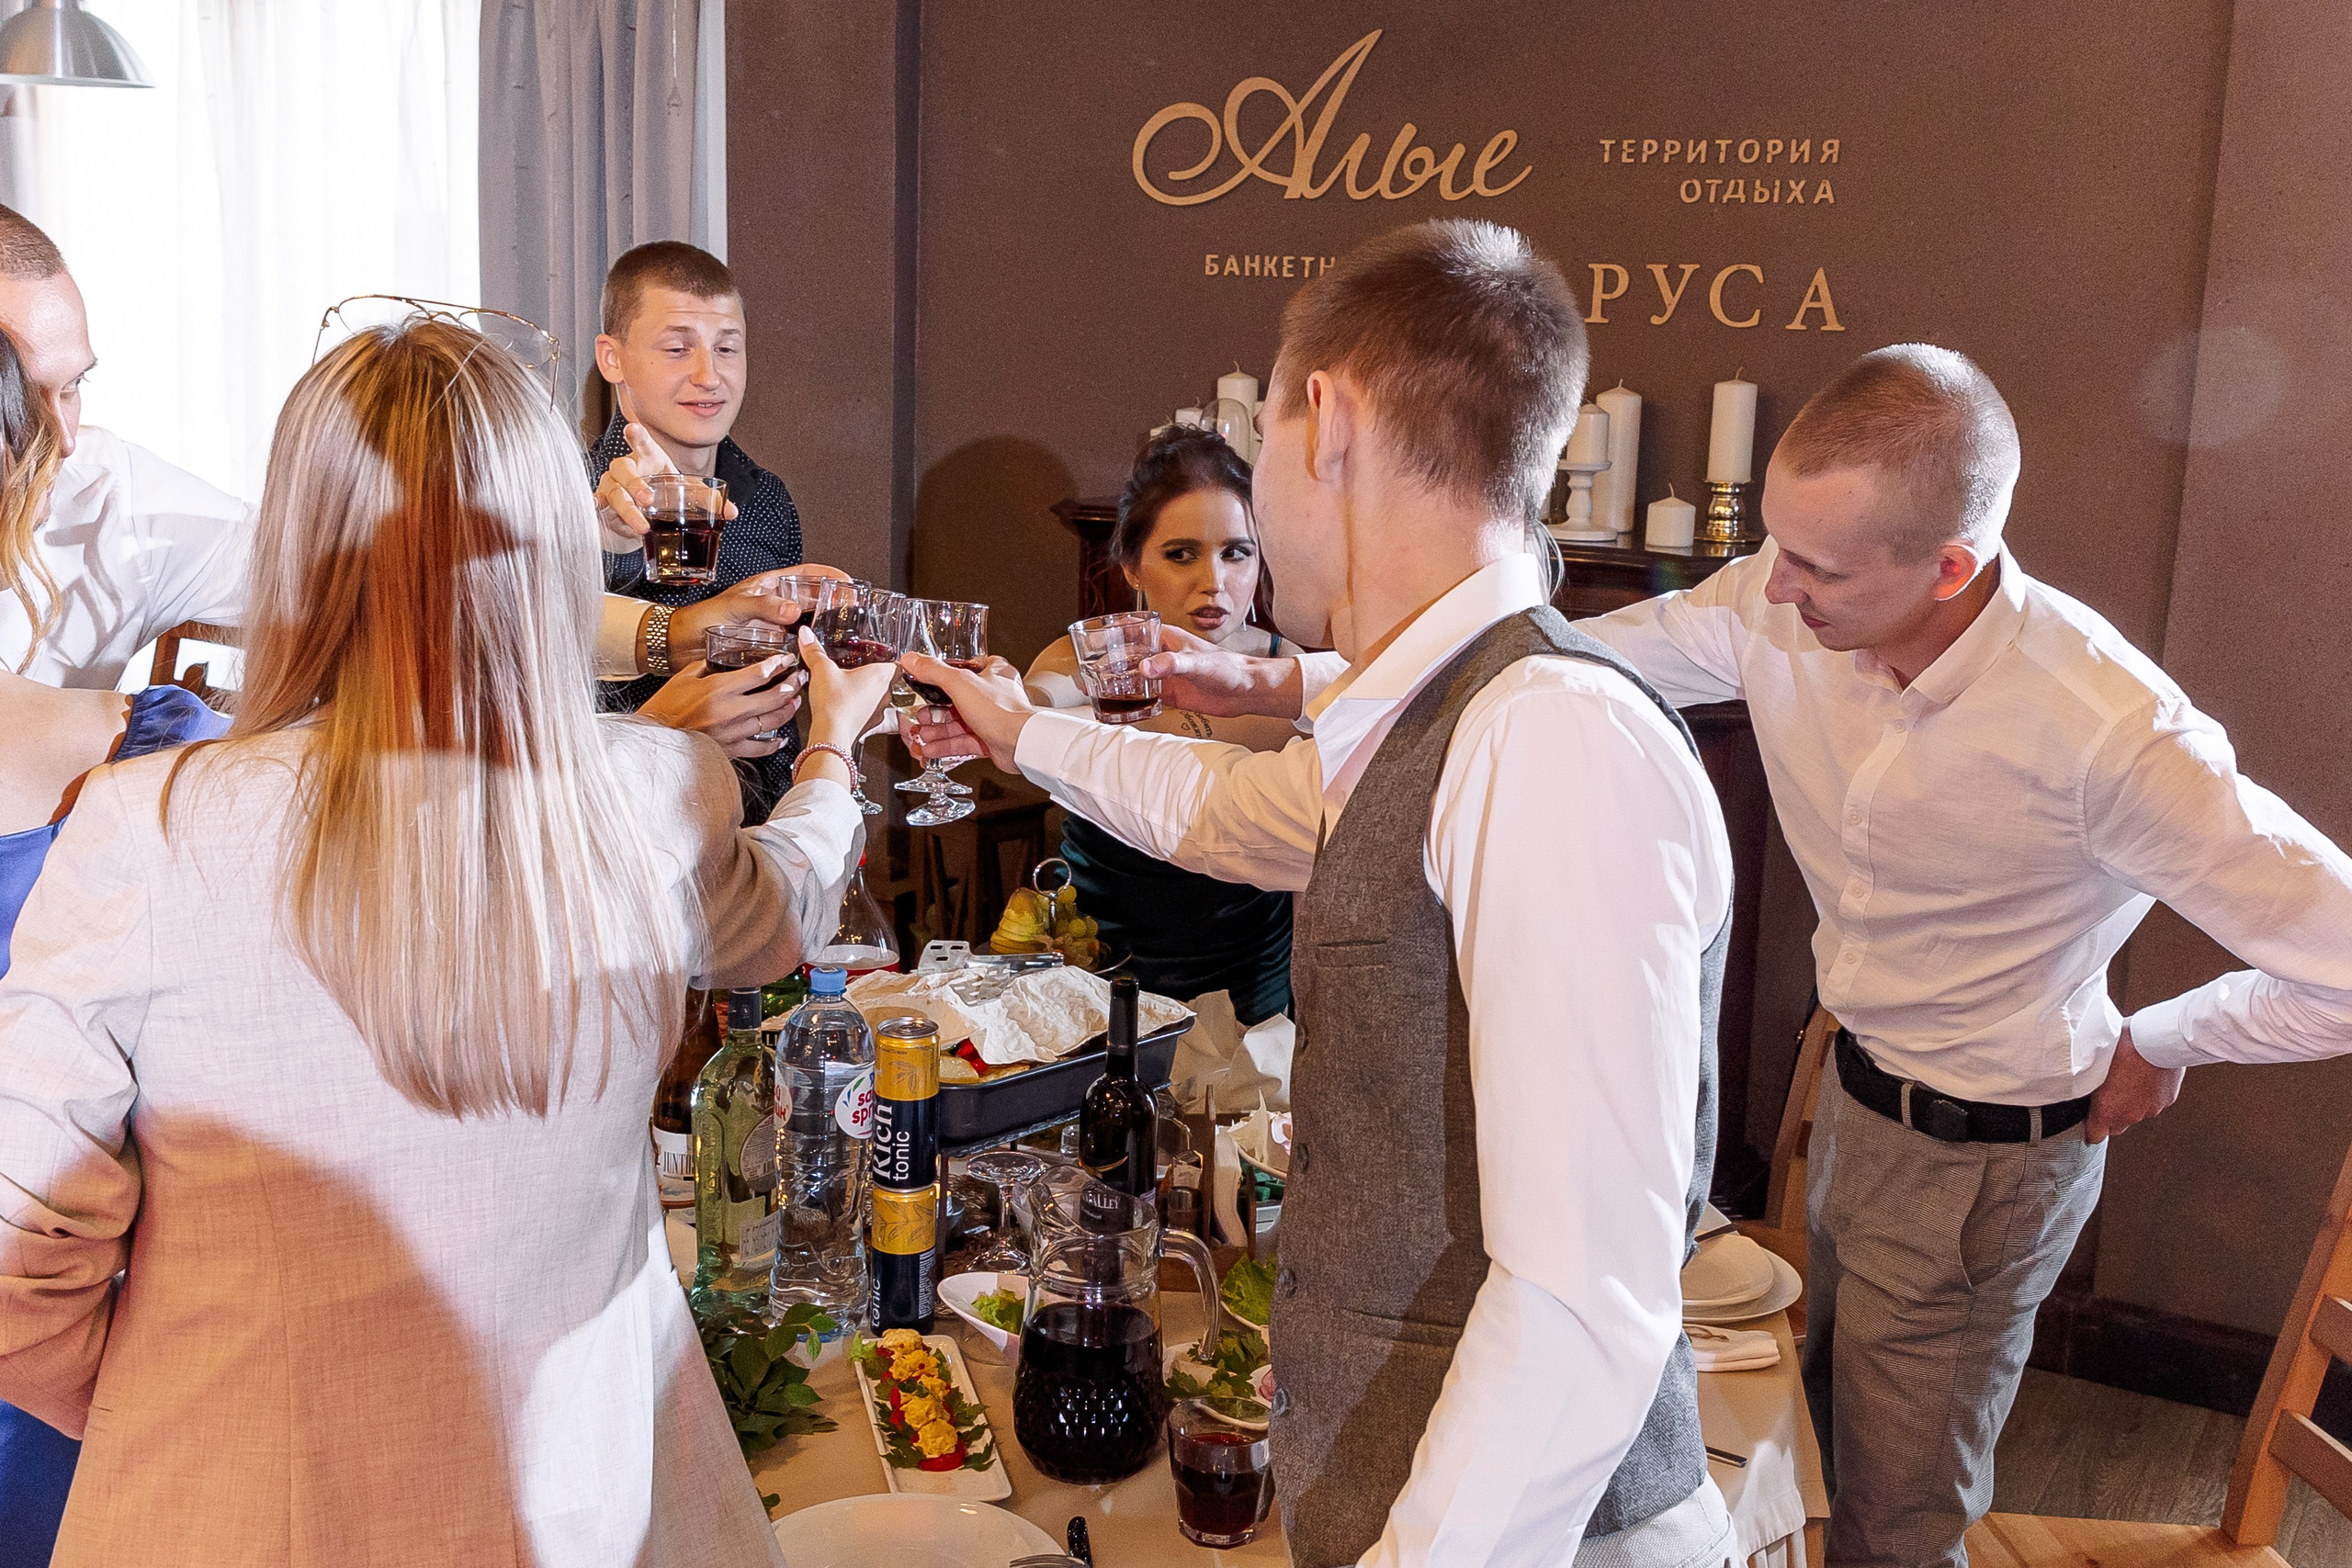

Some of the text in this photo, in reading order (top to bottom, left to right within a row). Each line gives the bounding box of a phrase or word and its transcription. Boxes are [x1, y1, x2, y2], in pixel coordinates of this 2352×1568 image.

[1132, 28, 1533, 207] Алые
[1600, 139, 1840, 164] ТЕРРИТОРИЯ
[1679, 179, 1836, 204] ОТДЫХА
[1204, 254, 1336, 278] БАНКЕТН
[1584, 263, 1846, 332] РУСА
[662, 1151, 695, 1175] JUNTO
[892, 1131, 910, 1182] tonic
